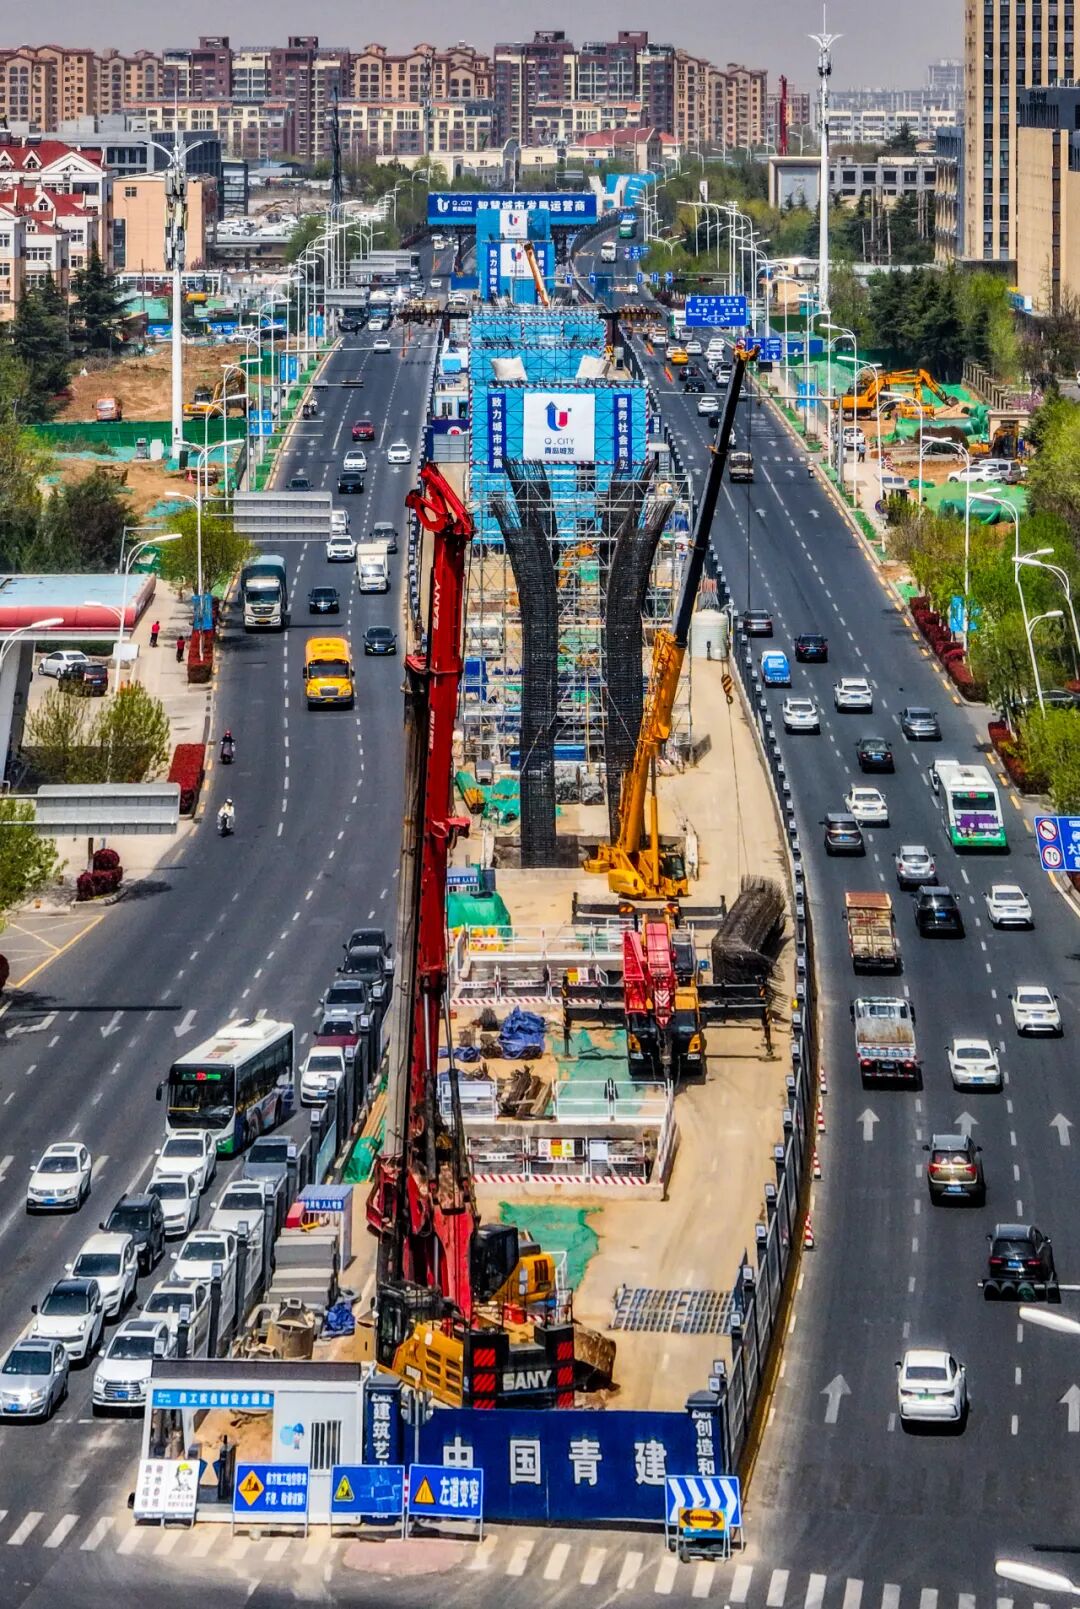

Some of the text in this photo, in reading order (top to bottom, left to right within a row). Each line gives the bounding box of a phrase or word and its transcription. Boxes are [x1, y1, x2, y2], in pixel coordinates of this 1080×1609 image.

[478, 200, 585, 212] 智慧城市发展运营商
[492, 397, 503, 469] 致力城市发展
[544, 447, 575, 455] 青岛城发
[432, 579, 441, 631] SANY
[502, 1369, 553, 1392] SANY
[372, 1403, 391, 1466] 建筑艺
[443, 1436, 667, 1486] 中国青建
[439, 1477, 480, 1509] 左道变窄
